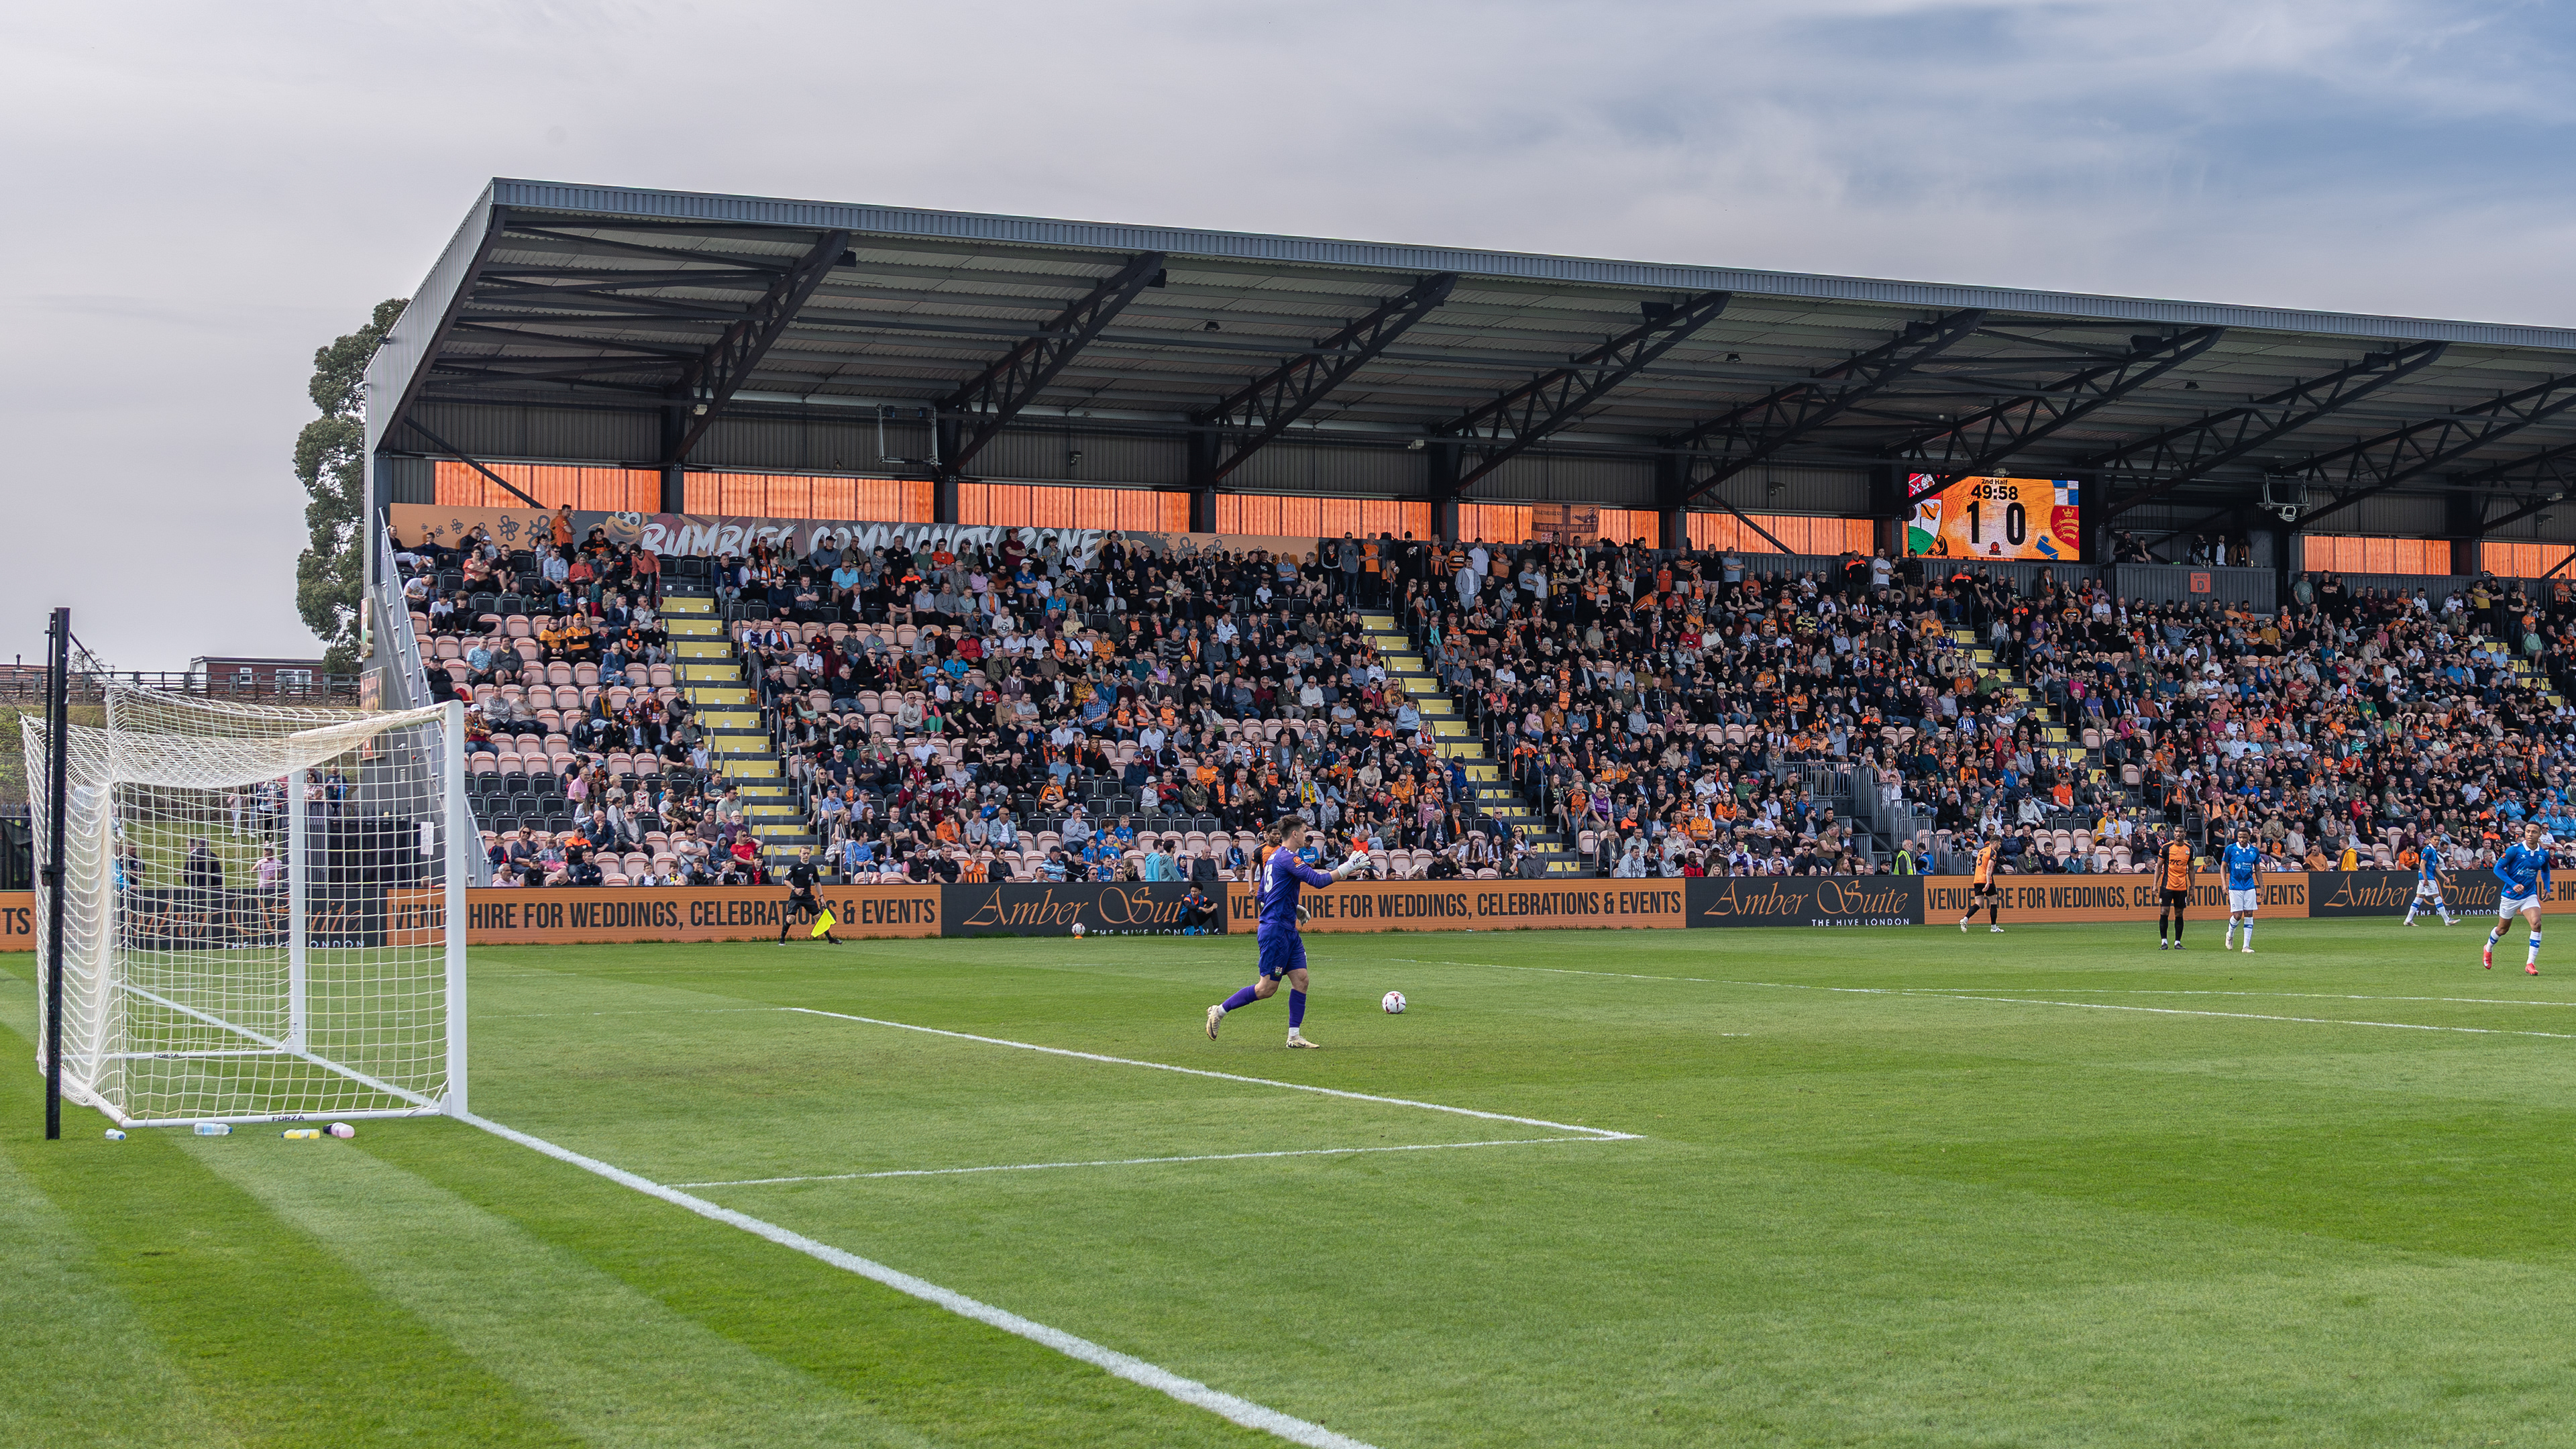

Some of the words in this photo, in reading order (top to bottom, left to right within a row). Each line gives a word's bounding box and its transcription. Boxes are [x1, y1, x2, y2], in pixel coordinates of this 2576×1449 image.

[1971, 484, 2019, 500] 49:58
[1967, 500, 1980, 544] 1
[2006, 502, 2026, 545] 0
[2197, 580, 2205, 591] D
[1704, 879, 1809, 916] Amber
[1817, 879, 1909, 914] Suite
[2018, 887, 2046, 908] FOR
[2049, 885, 2129, 911] WEDDINGS,
[2324, 873, 2412, 906] Amber
[469, 903, 517, 929] HIRE
[524, 902, 564, 929] FOR
[570, 901, 684, 930] WEDDINGS,
[843, 900, 855, 924] &
[862, 898, 936, 924] EVENTS
[963, 885, 1089, 926] Amber
[1098, 885, 1185, 925] Sui
[1340, 894, 1373, 918] FOR
[1377, 893, 1472, 920] WEDDINGS,
[1477, 892, 1599, 916] CELEBRATIONS
[1604, 892, 1615, 914] &
[1619, 891, 1681, 914] EVENTS
[1811, 919, 1830, 927] THE
[1836, 918, 1859, 926] HIVE
[1865, 918, 1910, 926] LONDON
